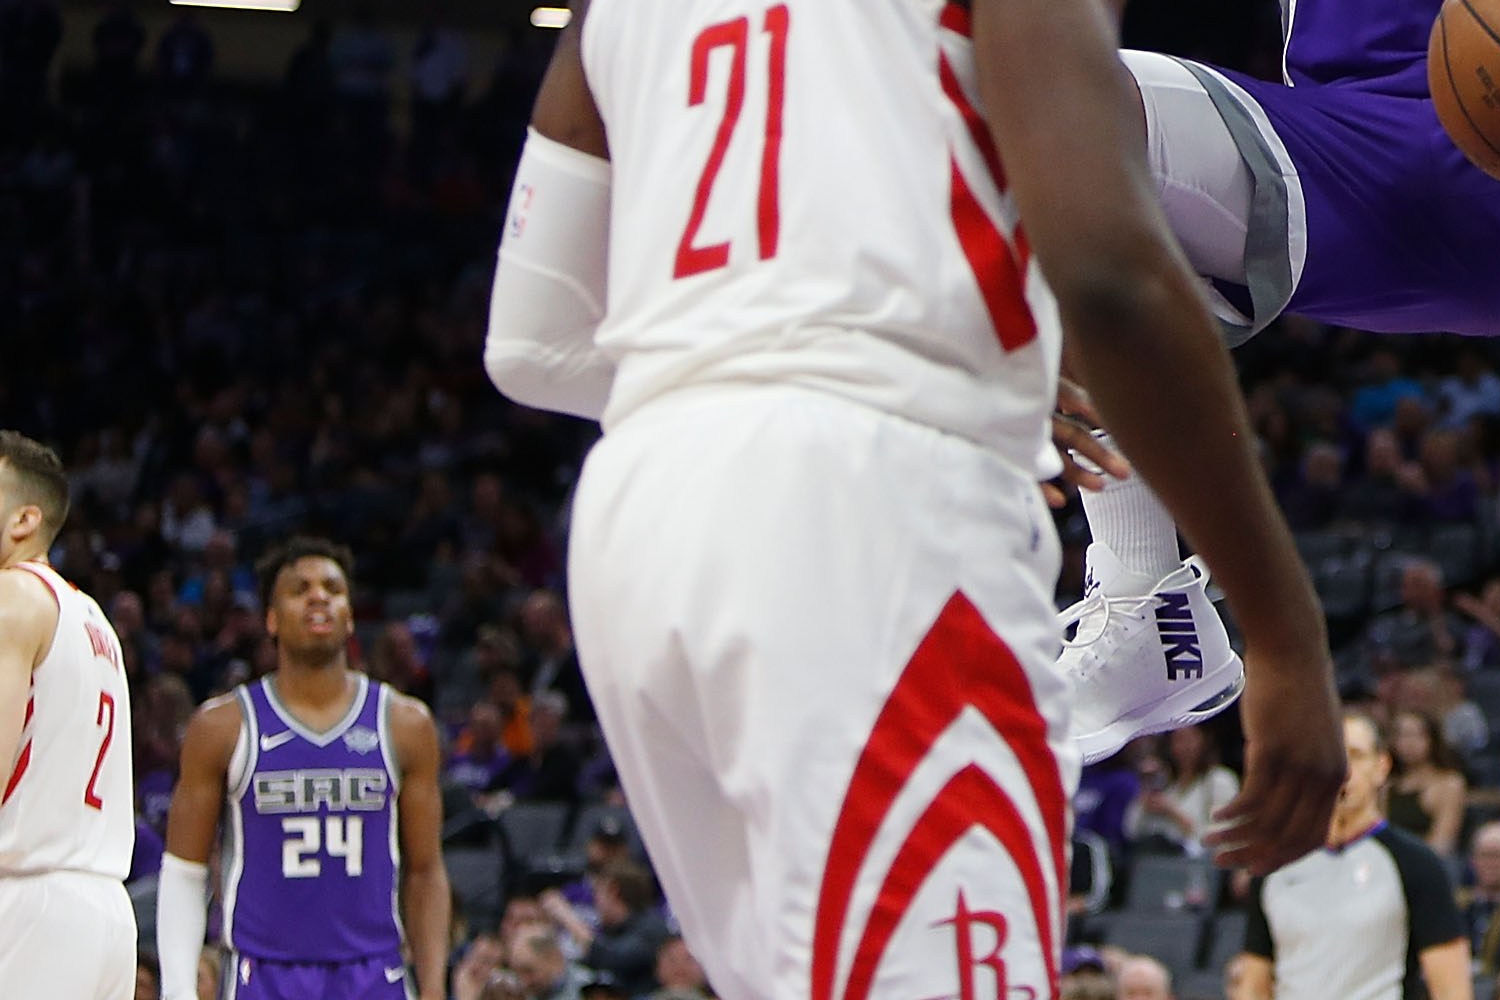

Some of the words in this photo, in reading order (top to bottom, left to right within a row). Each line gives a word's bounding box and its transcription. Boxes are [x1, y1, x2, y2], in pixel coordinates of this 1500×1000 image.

[672, 2, 789, 280] 21
[1154, 592, 1203, 681] NIKE
[84, 689, 115, 811] 2
[253, 768, 388, 815] SAC
[281, 815, 363, 878] 24
